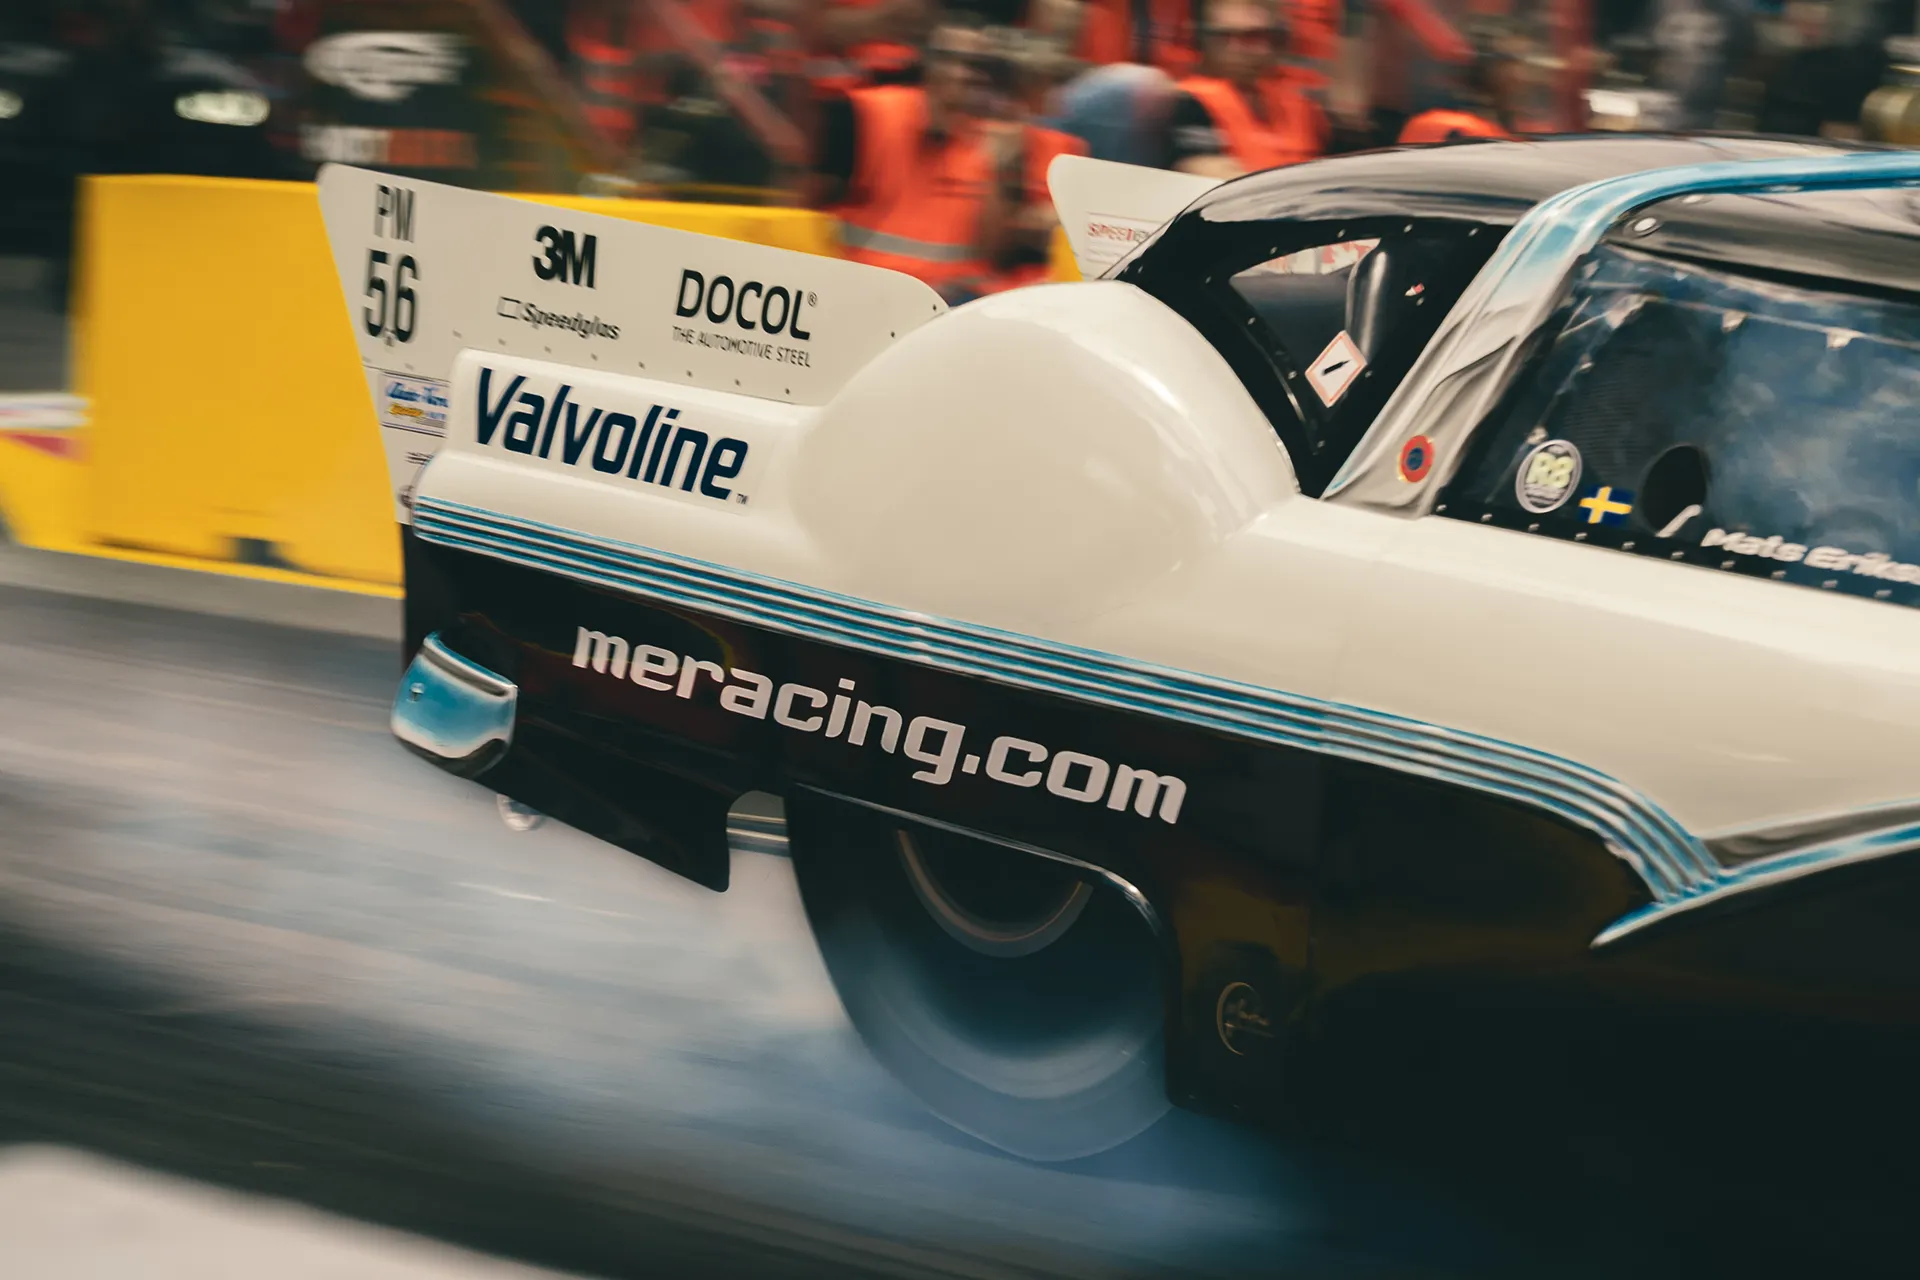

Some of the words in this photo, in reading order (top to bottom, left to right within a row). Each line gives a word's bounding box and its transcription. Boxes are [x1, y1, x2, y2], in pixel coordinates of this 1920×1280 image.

[532, 225, 597, 289] 3M
[521, 302, 620, 340] Speedglas
[672, 325, 695, 345] THE
[696, 330, 773, 361] AUTOMOTIVE
[775, 346, 812, 369] STEEL
[476, 366, 749, 500] Valvoline
[572, 626, 1187, 824] meracing.com
